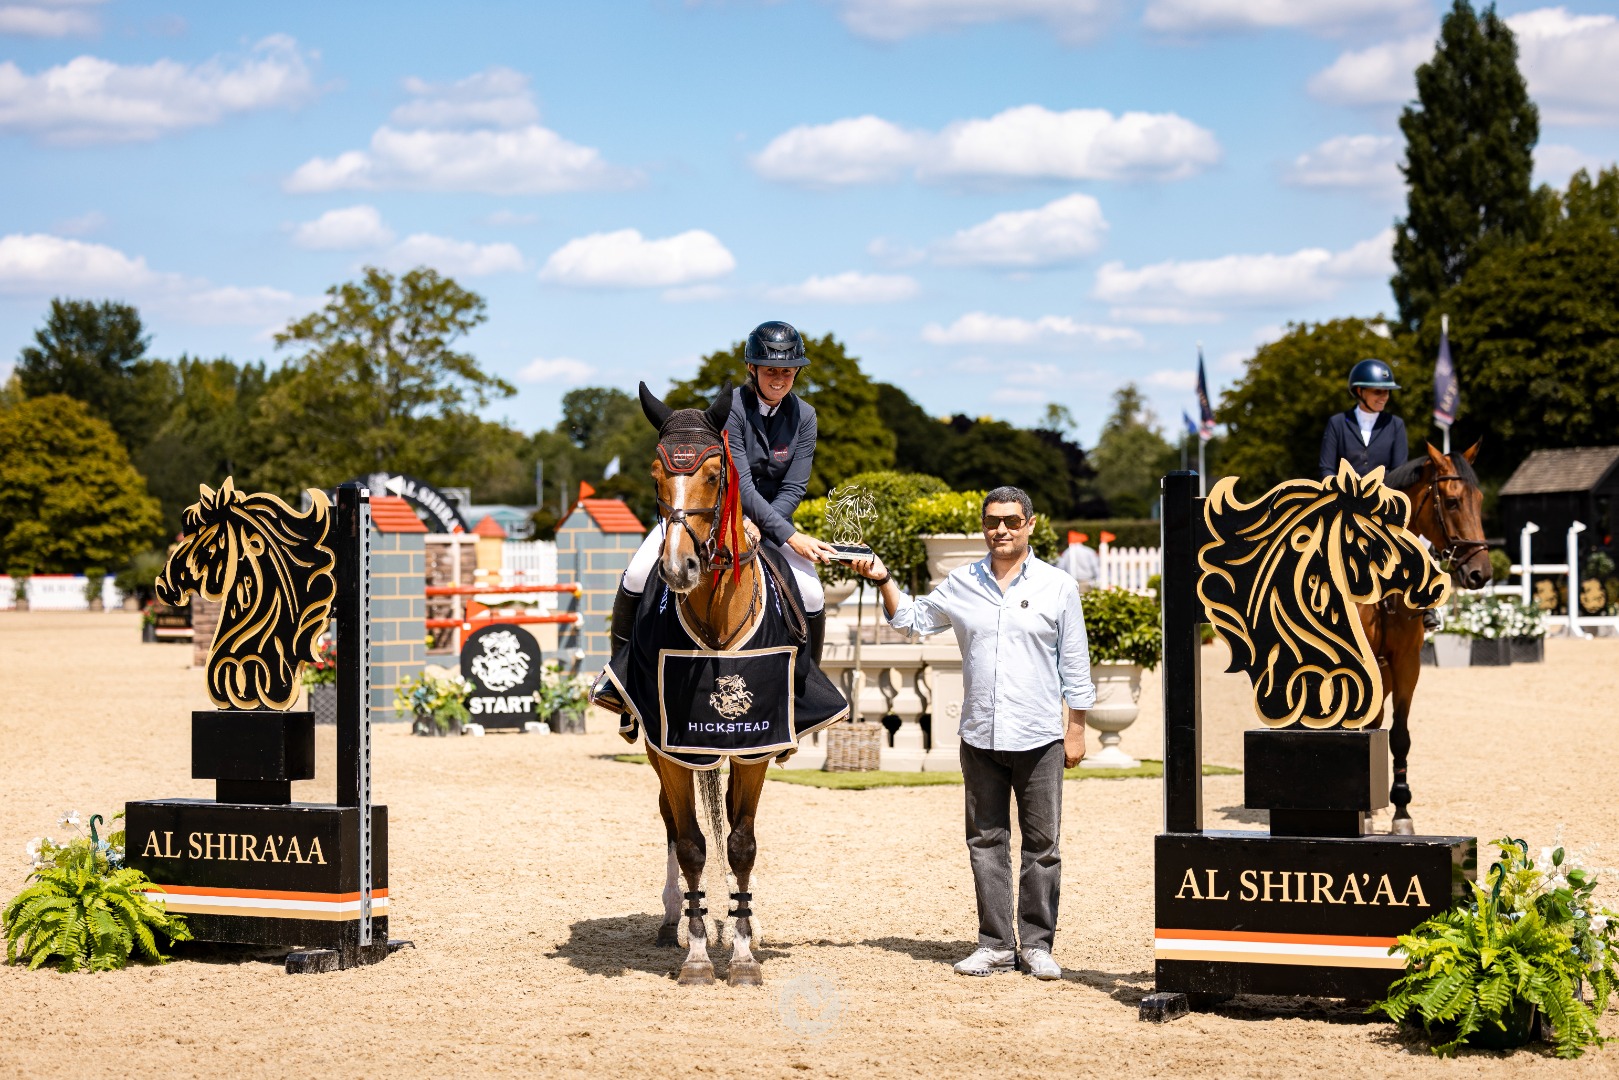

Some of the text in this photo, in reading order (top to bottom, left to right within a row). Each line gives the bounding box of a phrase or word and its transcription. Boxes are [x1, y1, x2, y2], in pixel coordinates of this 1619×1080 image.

[469, 696, 534, 714] START
[688, 721, 770, 733] HICKSTEAD
[142, 830, 328, 865] AL SHIRA'AA
[1175, 868, 1431, 907] AL SHIRA'AA
